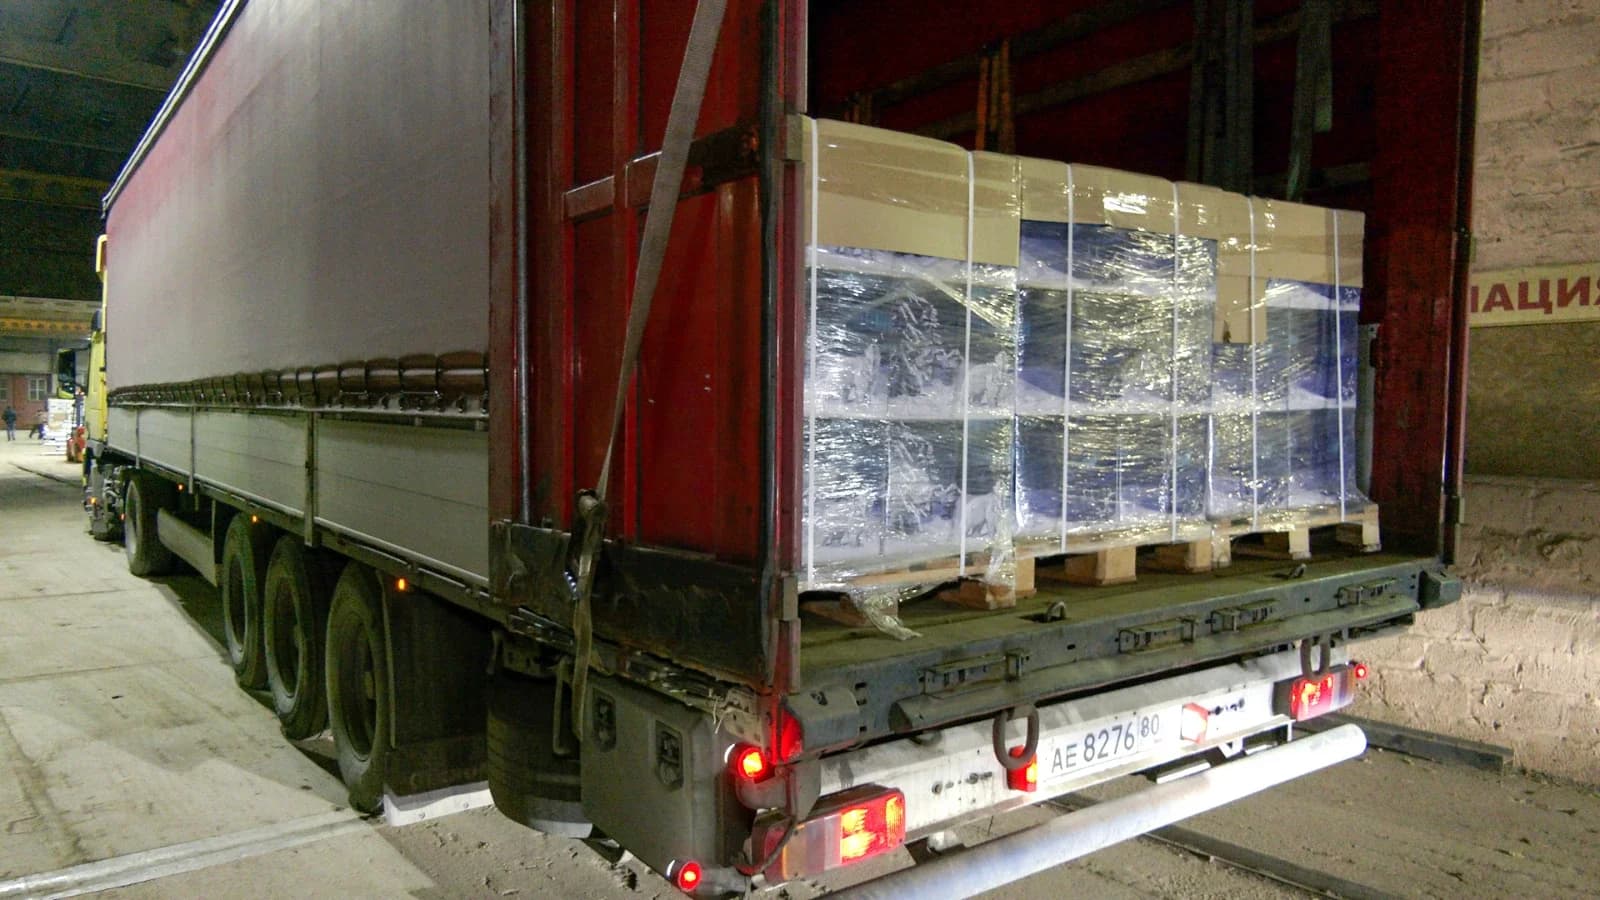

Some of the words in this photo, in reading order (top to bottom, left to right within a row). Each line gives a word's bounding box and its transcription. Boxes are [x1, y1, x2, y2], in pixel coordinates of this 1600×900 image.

[1470, 276, 1600, 314] АЦИ
[1083, 721, 1135, 762] 8276
[1141, 713, 1160, 738] 80
